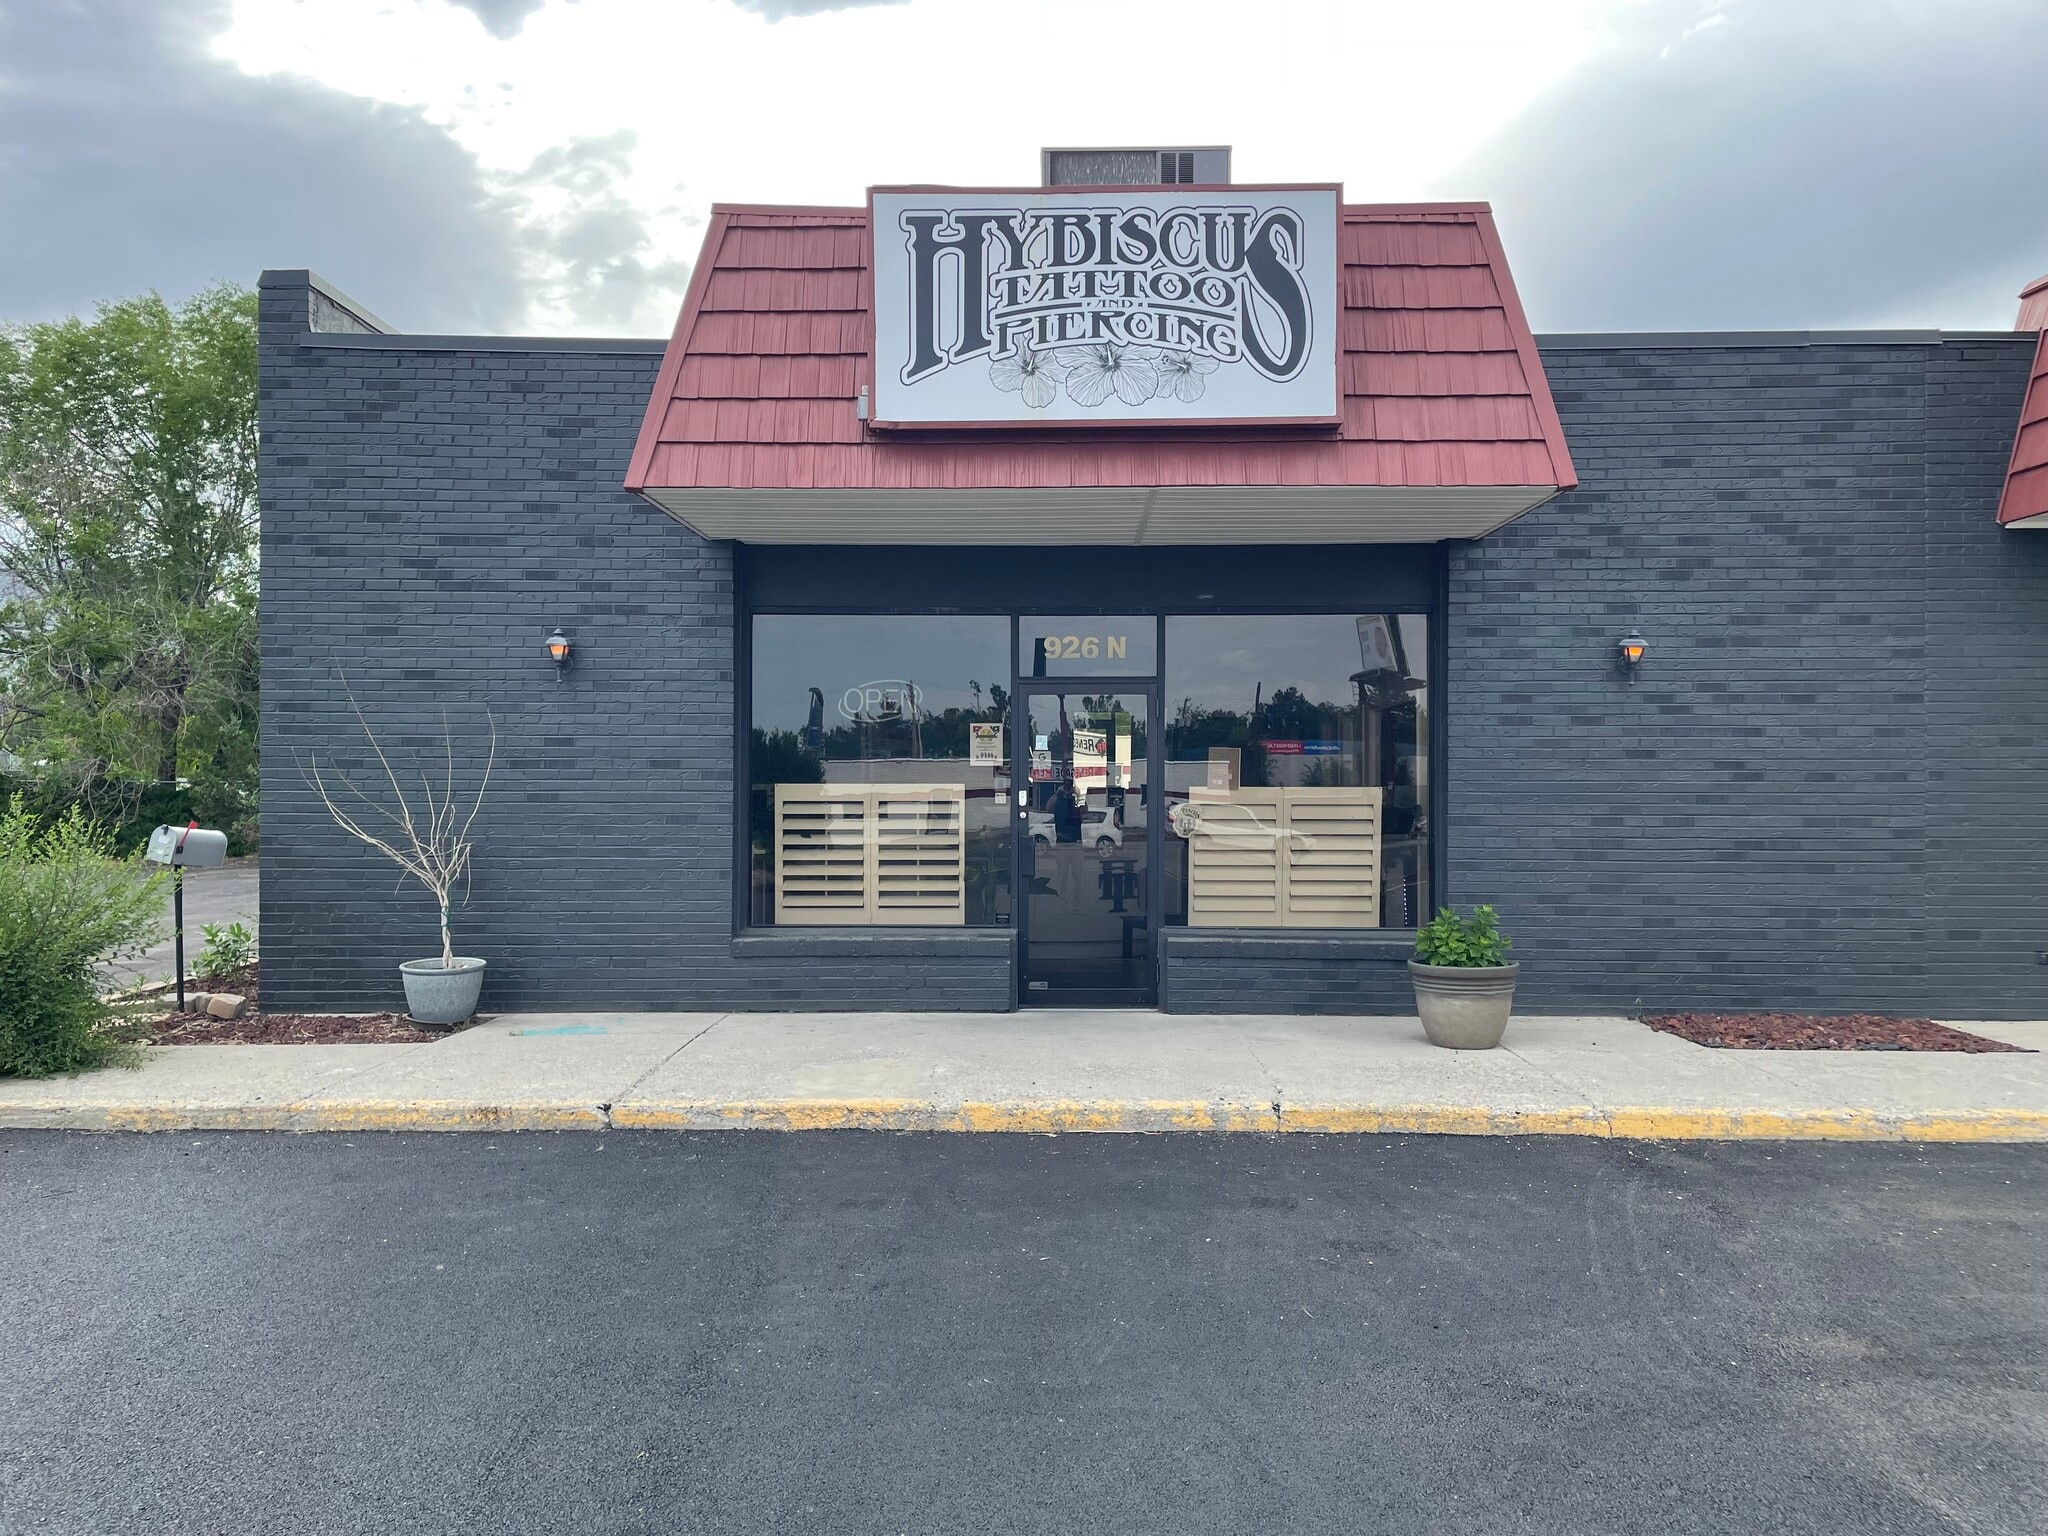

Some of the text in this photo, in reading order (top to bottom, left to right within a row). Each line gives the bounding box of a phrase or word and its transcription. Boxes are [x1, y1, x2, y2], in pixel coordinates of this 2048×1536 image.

[906, 212, 1307, 378] HYBISCUS
[996, 271, 1235, 307] TATTOO
[1095, 300, 1133, 308] AND
[996, 311, 1237, 356] PIERCING
[1044, 636, 1126, 659] 926 N
[844, 688, 917, 713] OPEN
